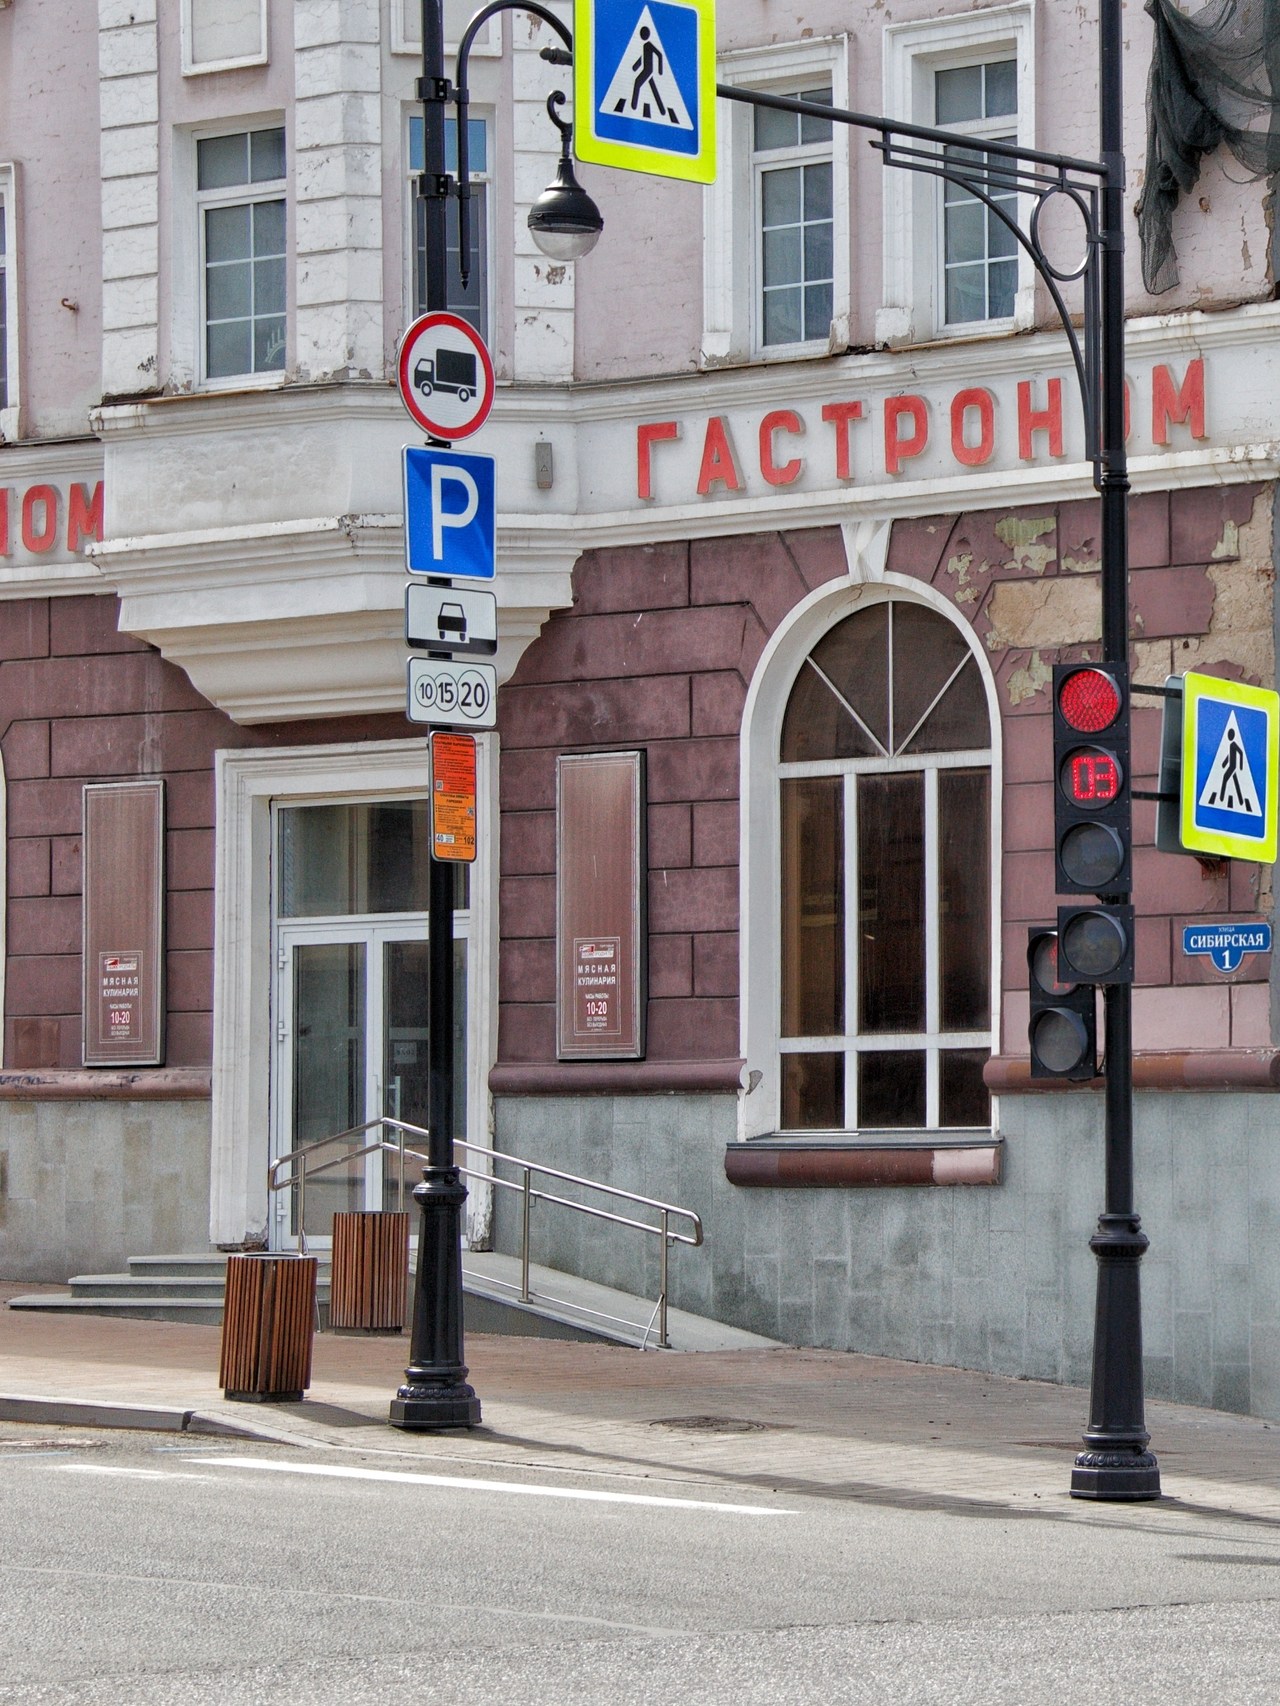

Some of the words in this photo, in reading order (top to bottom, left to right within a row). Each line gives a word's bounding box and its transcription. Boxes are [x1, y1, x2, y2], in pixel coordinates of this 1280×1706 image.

[637, 358, 1205, 498] ГАСТРОНМ
[0, 480, 105, 555] ОМ
[431, 463, 479, 560] P
[419, 682, 433, 700] 10
[438, 682, 454, 704] 15
[461, 681, 486, 708] 20
[1072, 755, 1118, 800] 03
[1190, 933, 1264, 948] СИБИРСКАЯ
[1222, 949, 1232, 969] 1
[578, 963, 616, 974] МЯСНАЯ
[103, 976, 138, 986] МЯСНАЯ
[578, 976, 616, 986] КУЛИНАРИЯ
[103, 987, 138, 997] КУЛИНАРИЯ
[586, 1001, 608, 1015] 10-20
[111, 1011, 131, 1024] 10-20
